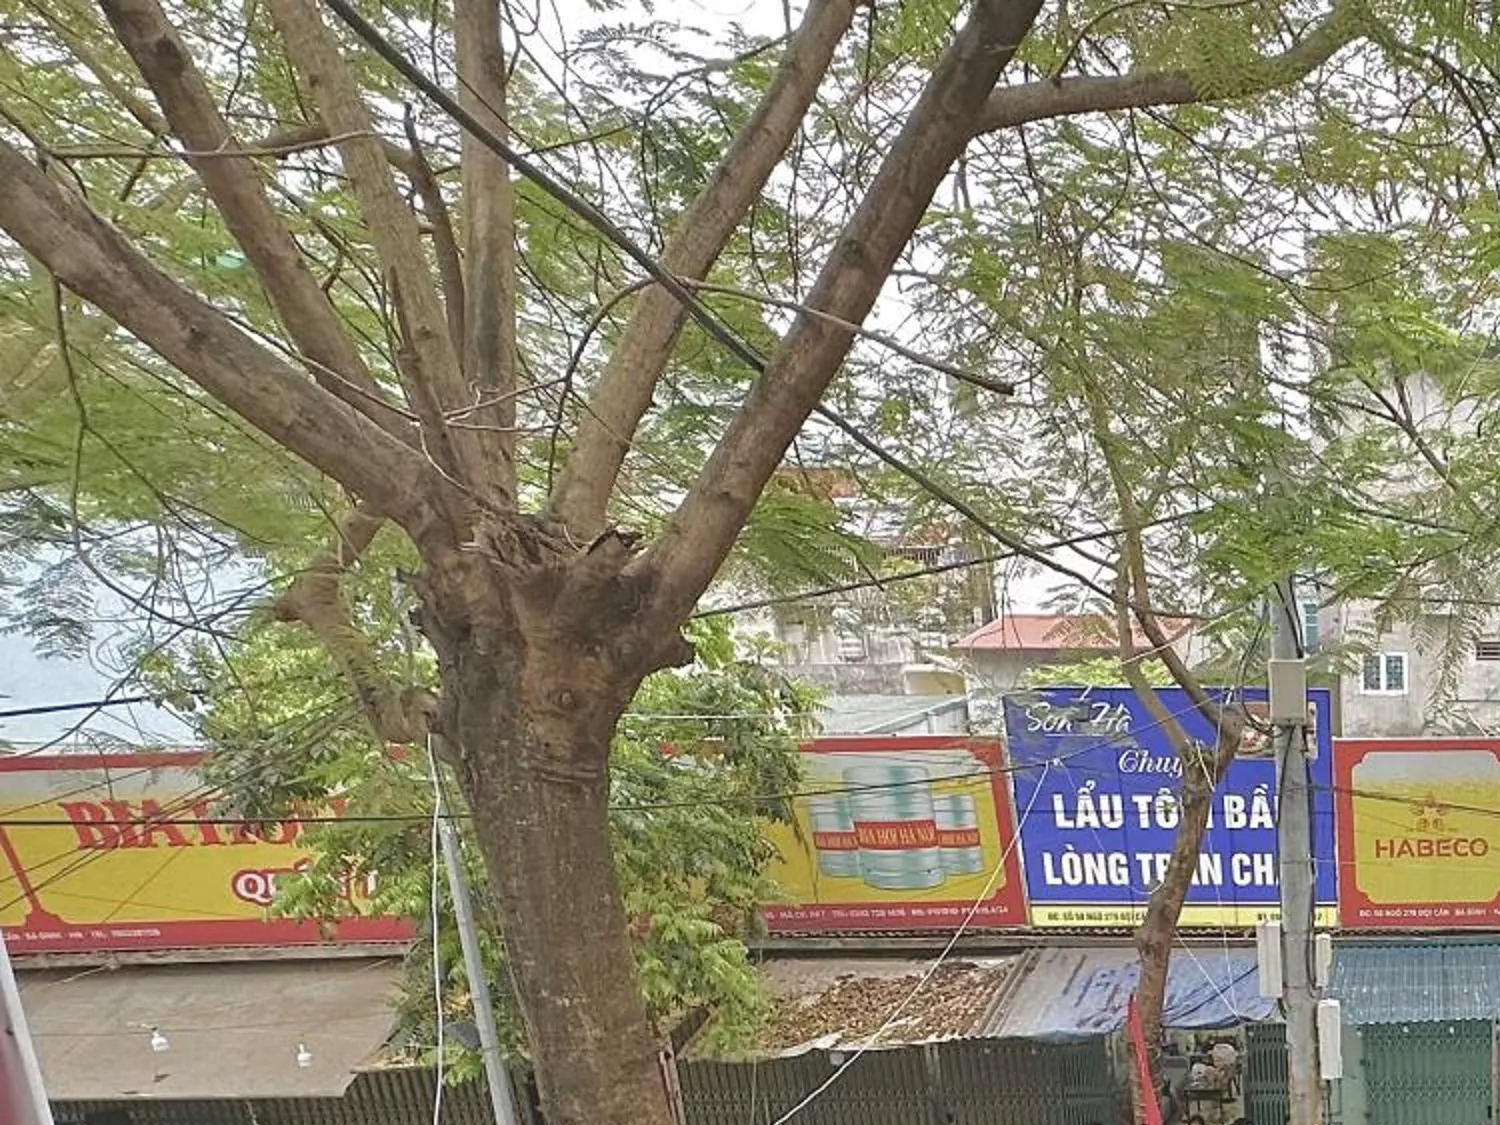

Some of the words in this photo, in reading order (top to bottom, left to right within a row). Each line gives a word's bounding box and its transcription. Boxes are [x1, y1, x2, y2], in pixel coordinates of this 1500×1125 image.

[1053, 780, 1123, 829] LẨU
[1132, 787, 1213, 829] TÔ
[1223, 783, 1279, 829] BẦ
[1042, 843, 1130, 886] LÒNG
[1135, 852, 1223, 886] TRN
[1375, 838, 1489, 859] HABECO
